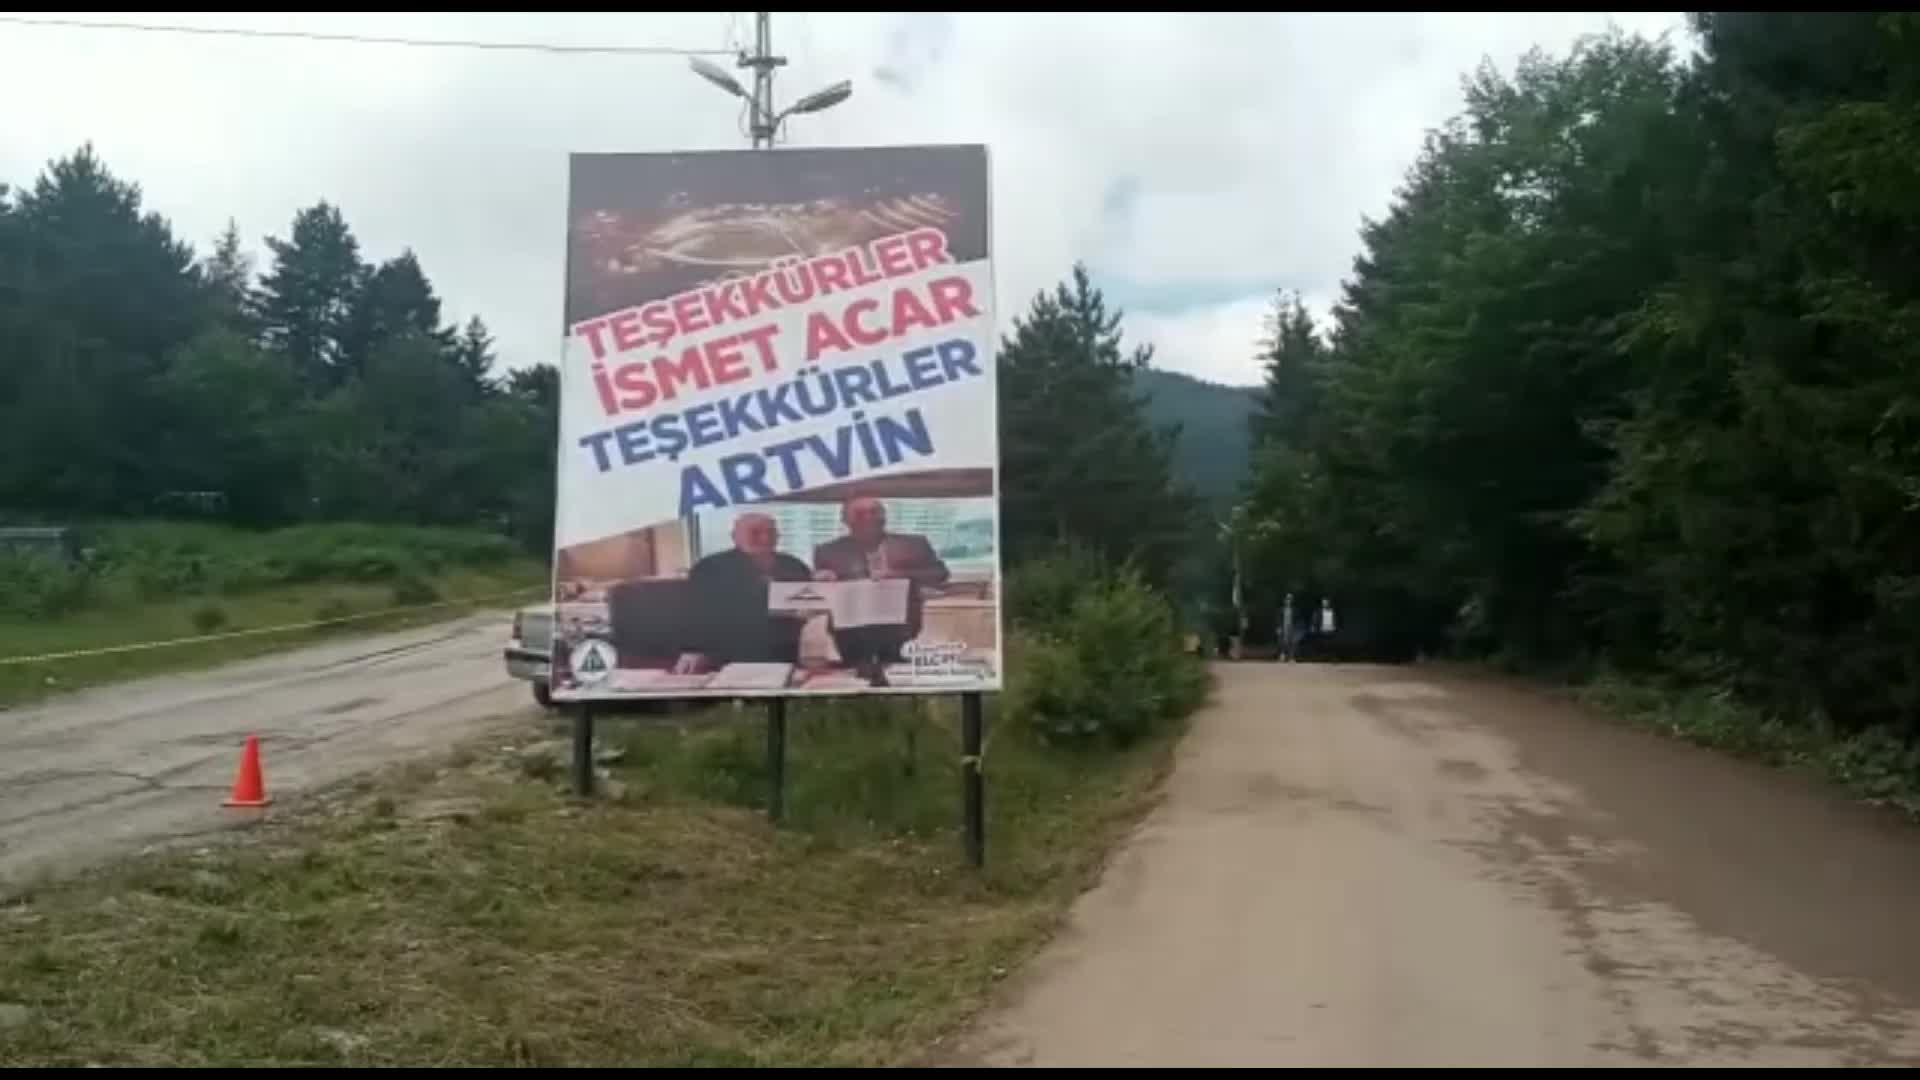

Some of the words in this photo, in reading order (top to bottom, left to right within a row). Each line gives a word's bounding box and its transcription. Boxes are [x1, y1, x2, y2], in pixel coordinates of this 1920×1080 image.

[575, 229, 951, 360] TEŞEKKÜRLER
[591, 324, 780, 416] İSMET
[805, 276, 980, 361] ACAR
[579, 338, 983, 473] TEŞEKKÜRLER
[678, 408, 935, 518] ARTVİN
